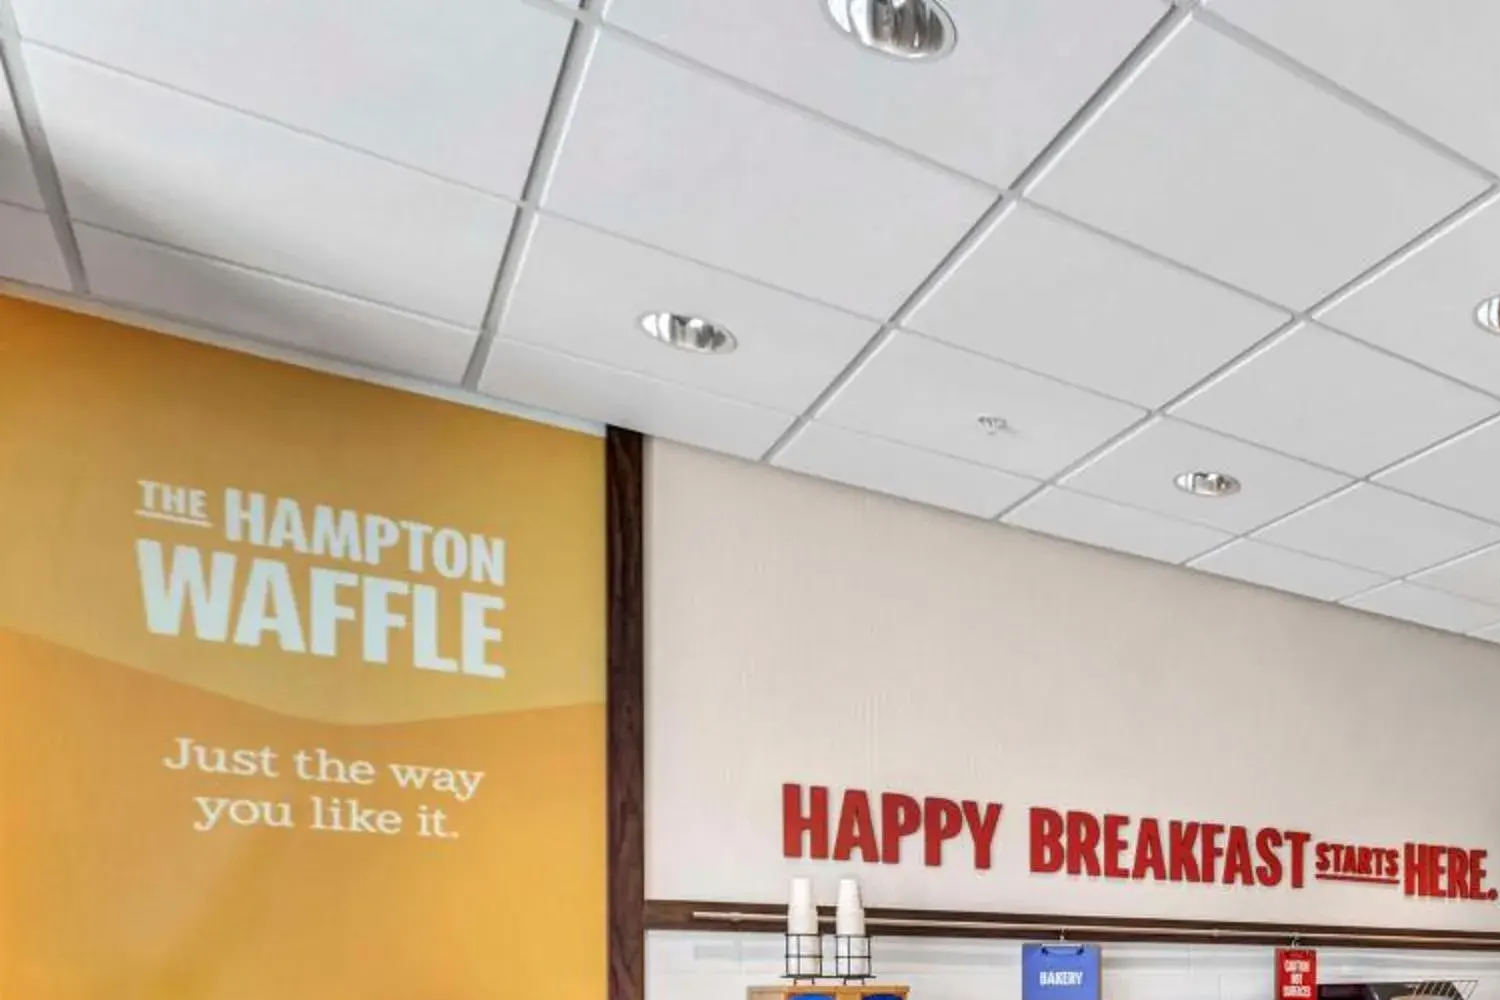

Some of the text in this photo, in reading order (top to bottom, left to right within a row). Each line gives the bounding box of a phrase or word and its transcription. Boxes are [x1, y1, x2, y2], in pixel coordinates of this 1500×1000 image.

[137, 480, 505, 586] THE HAMPTON
[136, 538, 506, 680] WAFFLE
[163, 737, 485, 802] Just the way
[193, 796, 460, 840] you like it.
[782, 783, 1499, 902] HAPPY BREAKFAST STARTS HERE.
[1039, 971, 1084, 986] BAKERY
